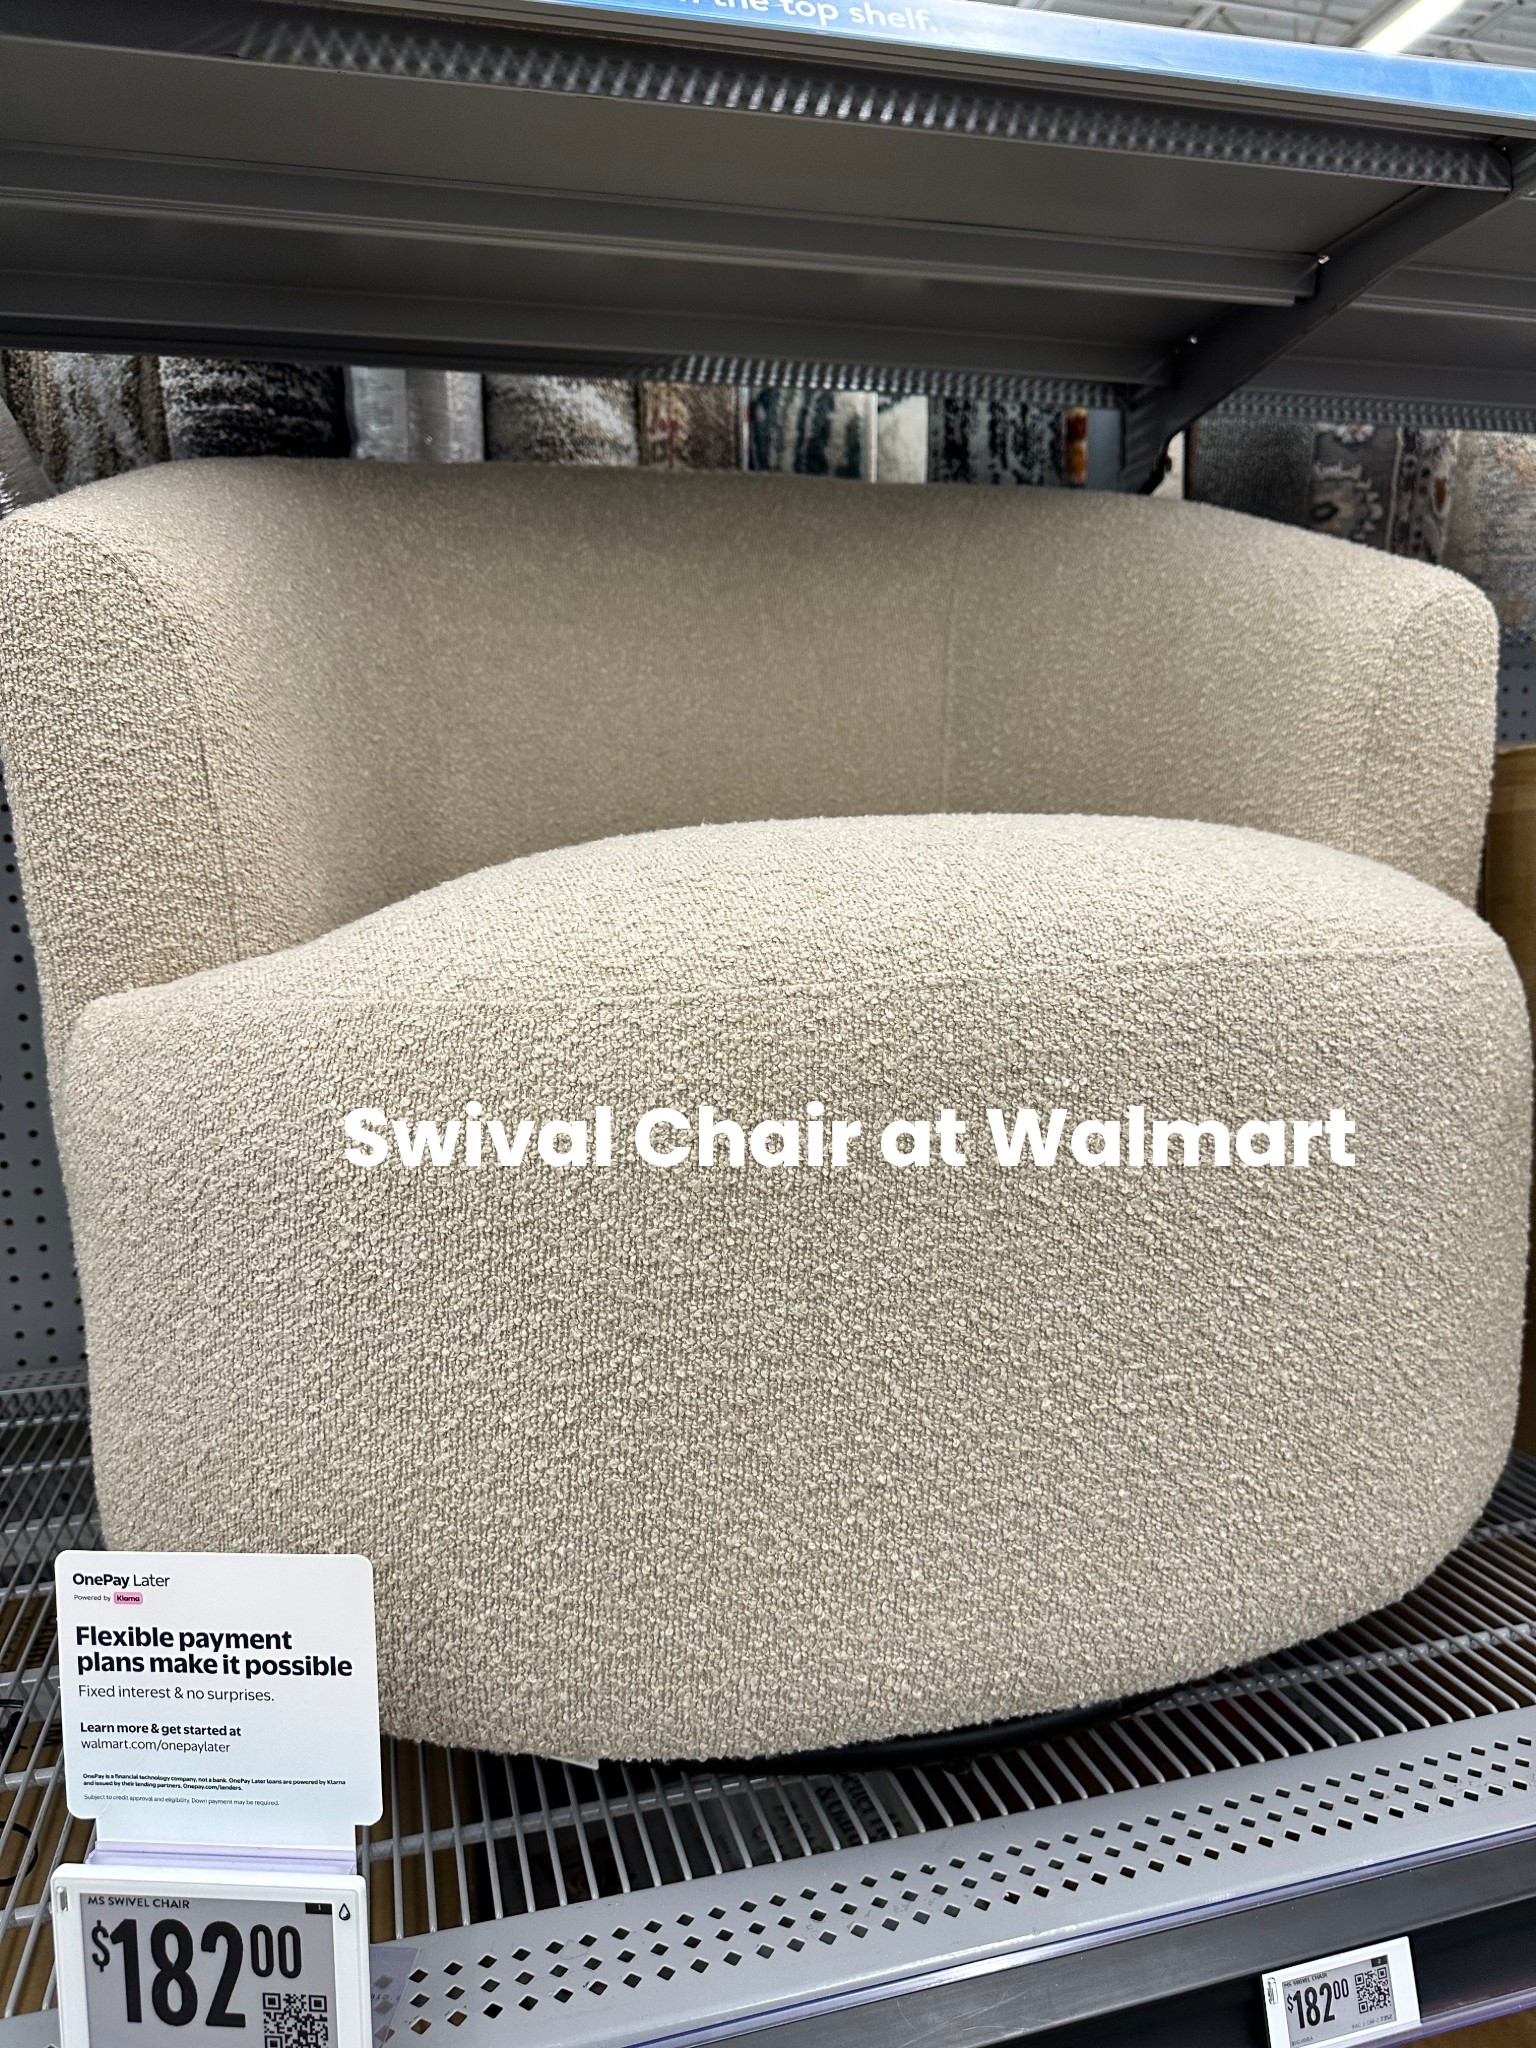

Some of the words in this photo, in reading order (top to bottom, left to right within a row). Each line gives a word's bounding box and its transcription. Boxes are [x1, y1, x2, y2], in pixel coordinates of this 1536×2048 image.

[782, 0, 839, 26] top
[848, 2, 939, 32] shelf.
[72, 1573, 130, 1589] OnePay
[133, 1574, 170, 1587] Later
[76, 1625, 174, 1648] Flexible
[179, 1630, 292, 1652] payment
[77, 1651, 145, 1675] plans
[150, 1653, 218, 1674] make
[222, 1654, 240, 1674] it
[245, 1655, 353, 1679] possible
[78, 1684, 115, 1698] Fixed
[118, 1685, 171, 1699] interest
[174, 1686, 184, 1699] &
[186, 1689, 204, 1700] no
[207, 1688, 275, 1703] surprises.
[80, 1722, 115, 1733] Learn
[116, 1724, 149, 1734] more
[150, 1723, 160, 1734] &
[161, 1725, 182, 1736] get
[183, 1725, 228, 1736] started
[229, 1726, 242, 1737] at
[81, 1738, 231, 1754] walmart.com/onepaylater
[228, 1777, 251, 1785] OnePay
[88, 1896, 105, 1905] MS
[108, 1896, 150, 1908] SWIVEL
[152, 1898, 190, 1909] CHAIR
